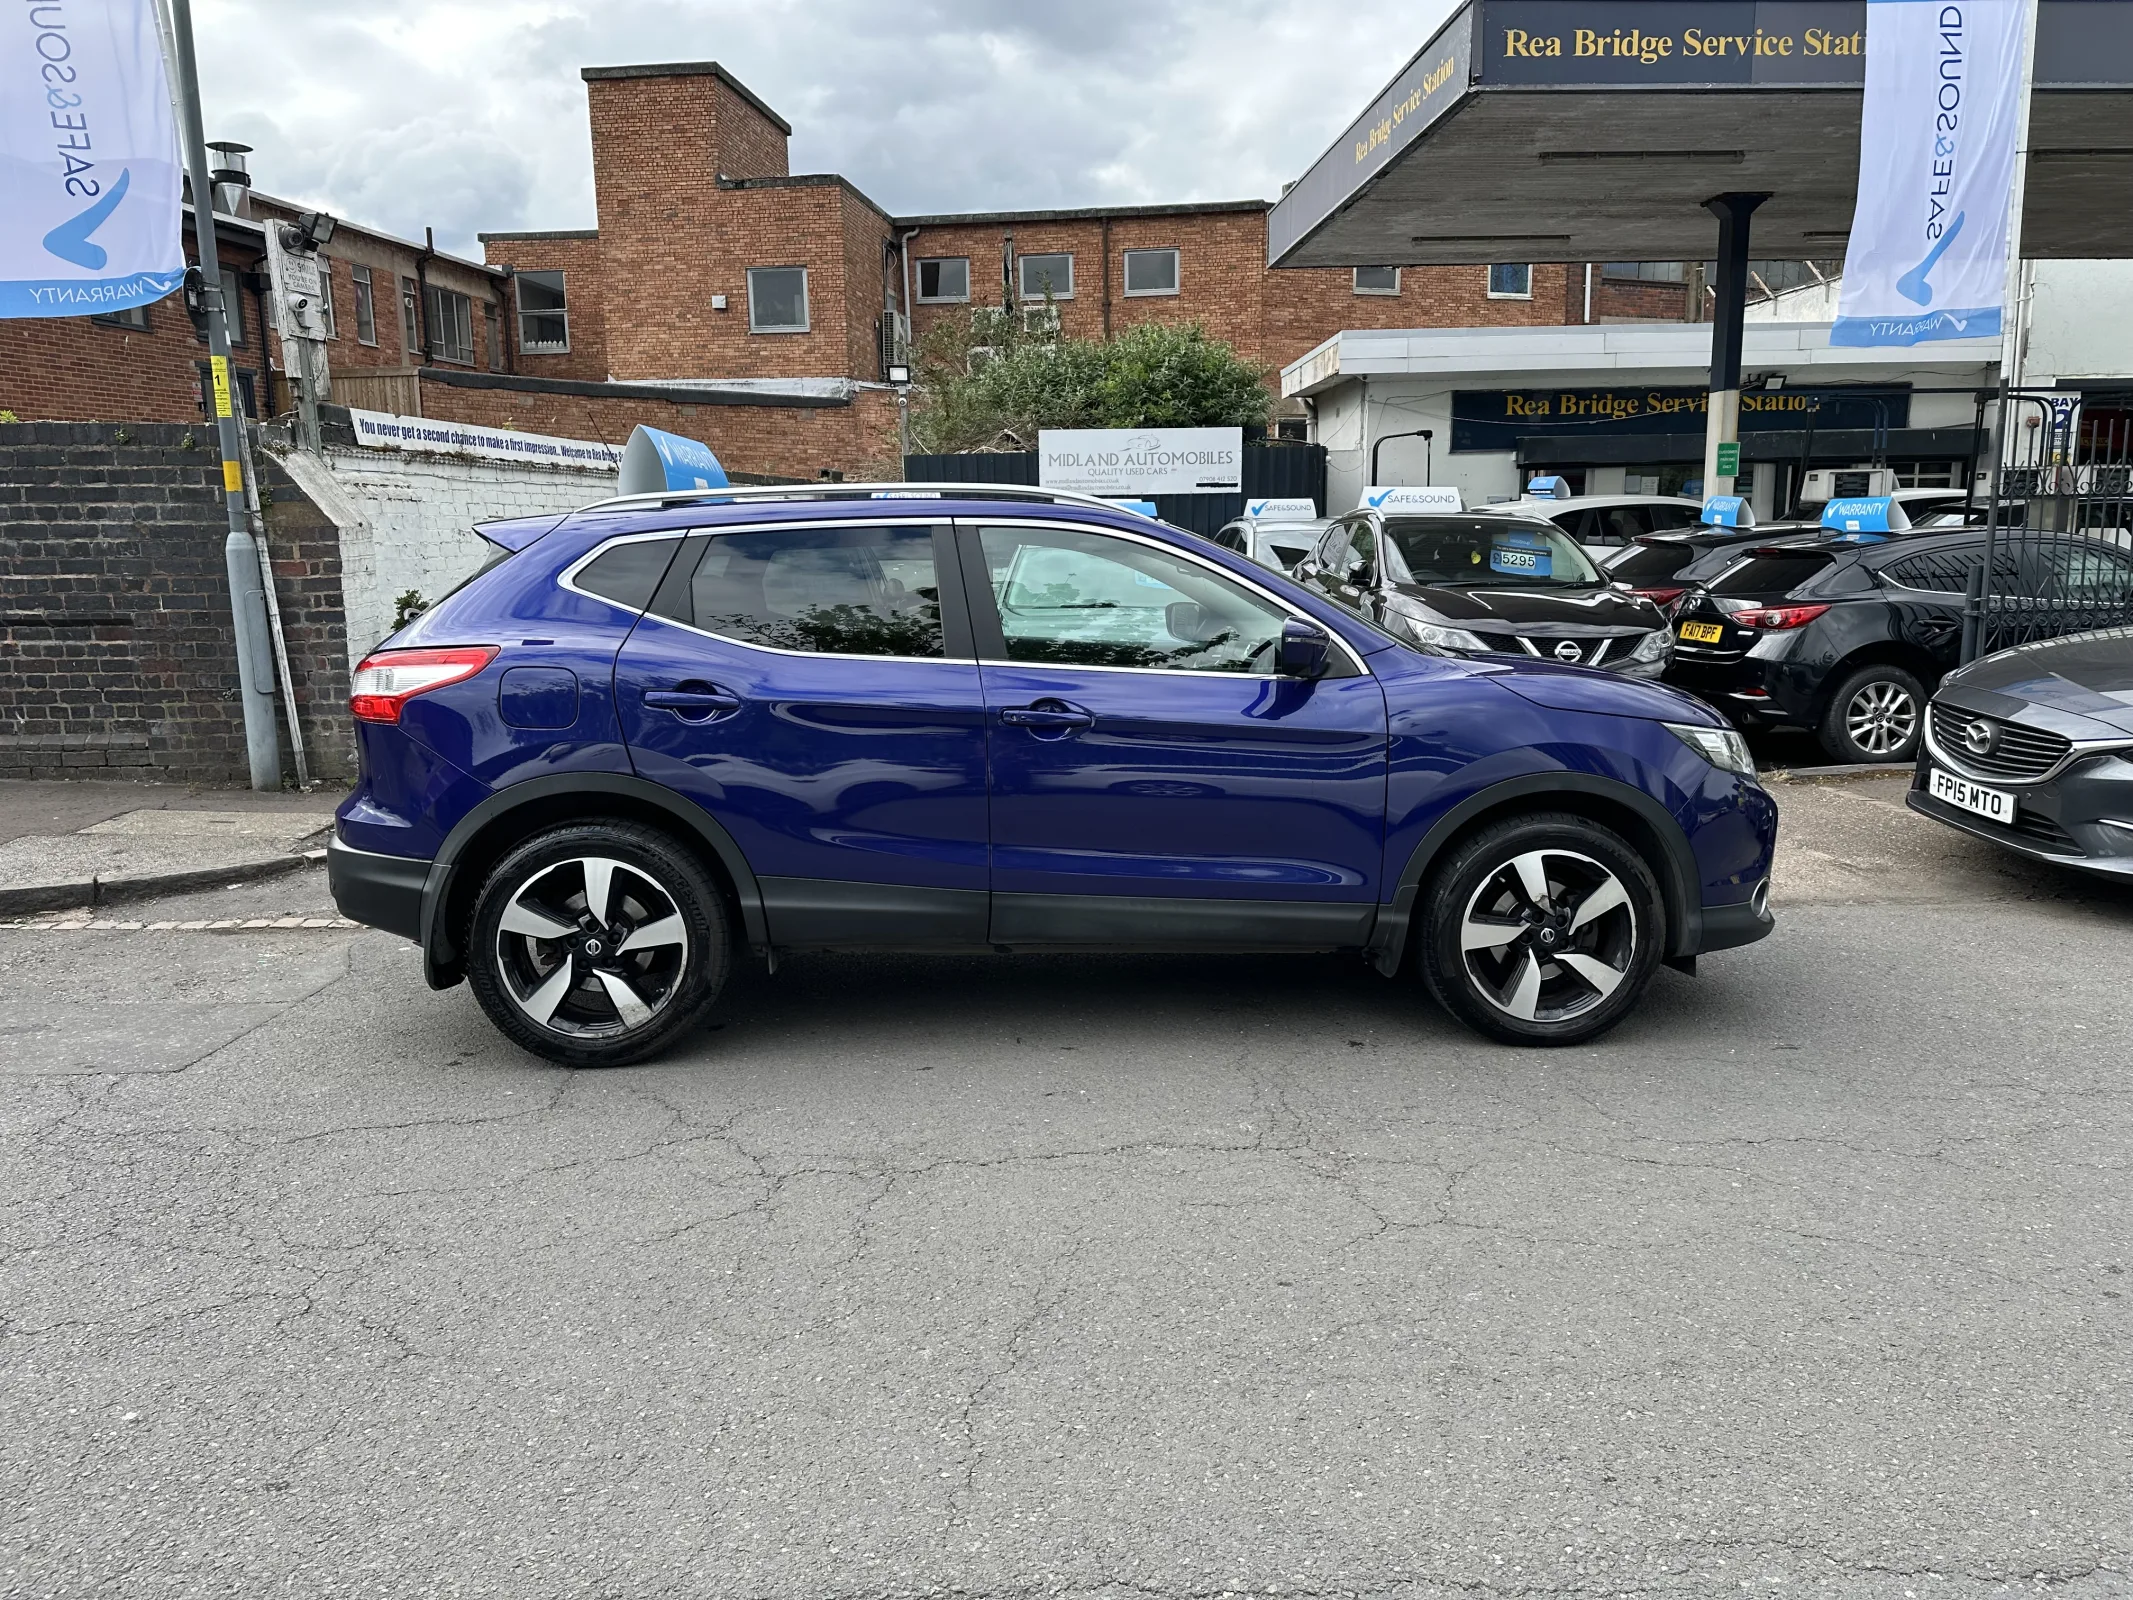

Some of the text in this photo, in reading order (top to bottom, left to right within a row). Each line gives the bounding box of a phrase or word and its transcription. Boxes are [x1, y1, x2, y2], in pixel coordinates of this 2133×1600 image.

[1503, 29, 1562, 58] Rea
[1572, 28, 1673, 64] Bridge
[1683, 28, 1794, 58] Service
[1355, 56, 1455, 164] Rea Bridge Service Station
[215, 375, 220, 386] 1
[1505, 395, 1550, 416] Rea
[1559, 393, 1639, 418] Bridge
[1647, 391, 1709, 413] Servi
[359, 418, 376, 435] You
[377, 423, 401, 438] never
[402, 426, 415, 440] get
[416, 428, 422, 440] a
[422, 428, 450, 444] second
[450, 431, 477, 446] chance
[477, 435, 485, 447] to
[486, 436, 505, 450] make
[504, 440, 510, 450] a
[510, 438, 524, 451] first
[561, 445, 586, 459] Welcome
[586, 447, 592, 459] to
[592, 448, 602, 461] Rea
[1048, 451, 1233, 467] MIDLAND AUTOMOBILES
[1088, 468, 1124, 477] QUALITY
[1146, 467, 1168, 475] CARS
[1264, 503, 1311, 512] SAFE&SOUND
[1387, 495, 1455, 504] SAFE&SOUND
[1838, 502, 1886, 516] WARRANTY
[1684, 623, 1718, 639] FA17 BPF
[1937, 773, 2002, 815] FP15 MTO
